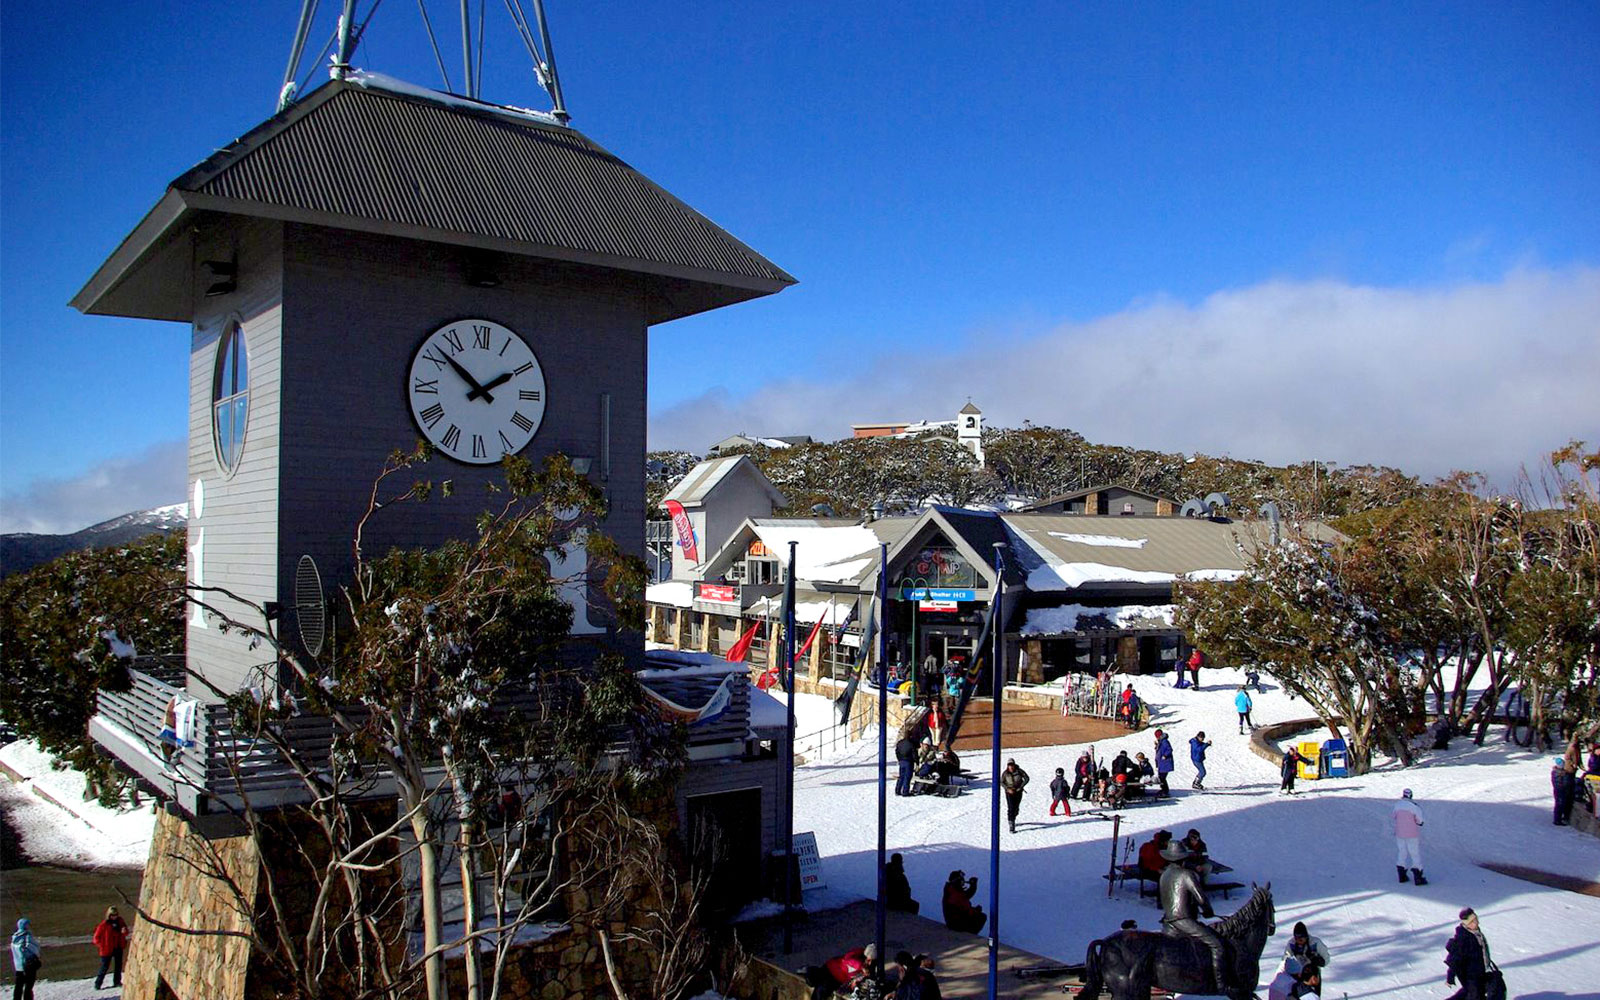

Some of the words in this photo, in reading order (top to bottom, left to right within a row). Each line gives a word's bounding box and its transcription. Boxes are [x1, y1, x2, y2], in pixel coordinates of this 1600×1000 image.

[442, 329, 464, 356] XI
[473, 325, 491, 350] XII
[499, 336, 512, 357] I
[422, 349, 447, 371] X
[513, 361, 534, 376] II
[414, 377, 439, 394] IX
[519, 389, 540, 401] III
[419, 402, 445, 430] VIII
[440, 424, 461, 452] VII
[472, 434, 487, 458] VI
[499, 429, 514, 451] V
